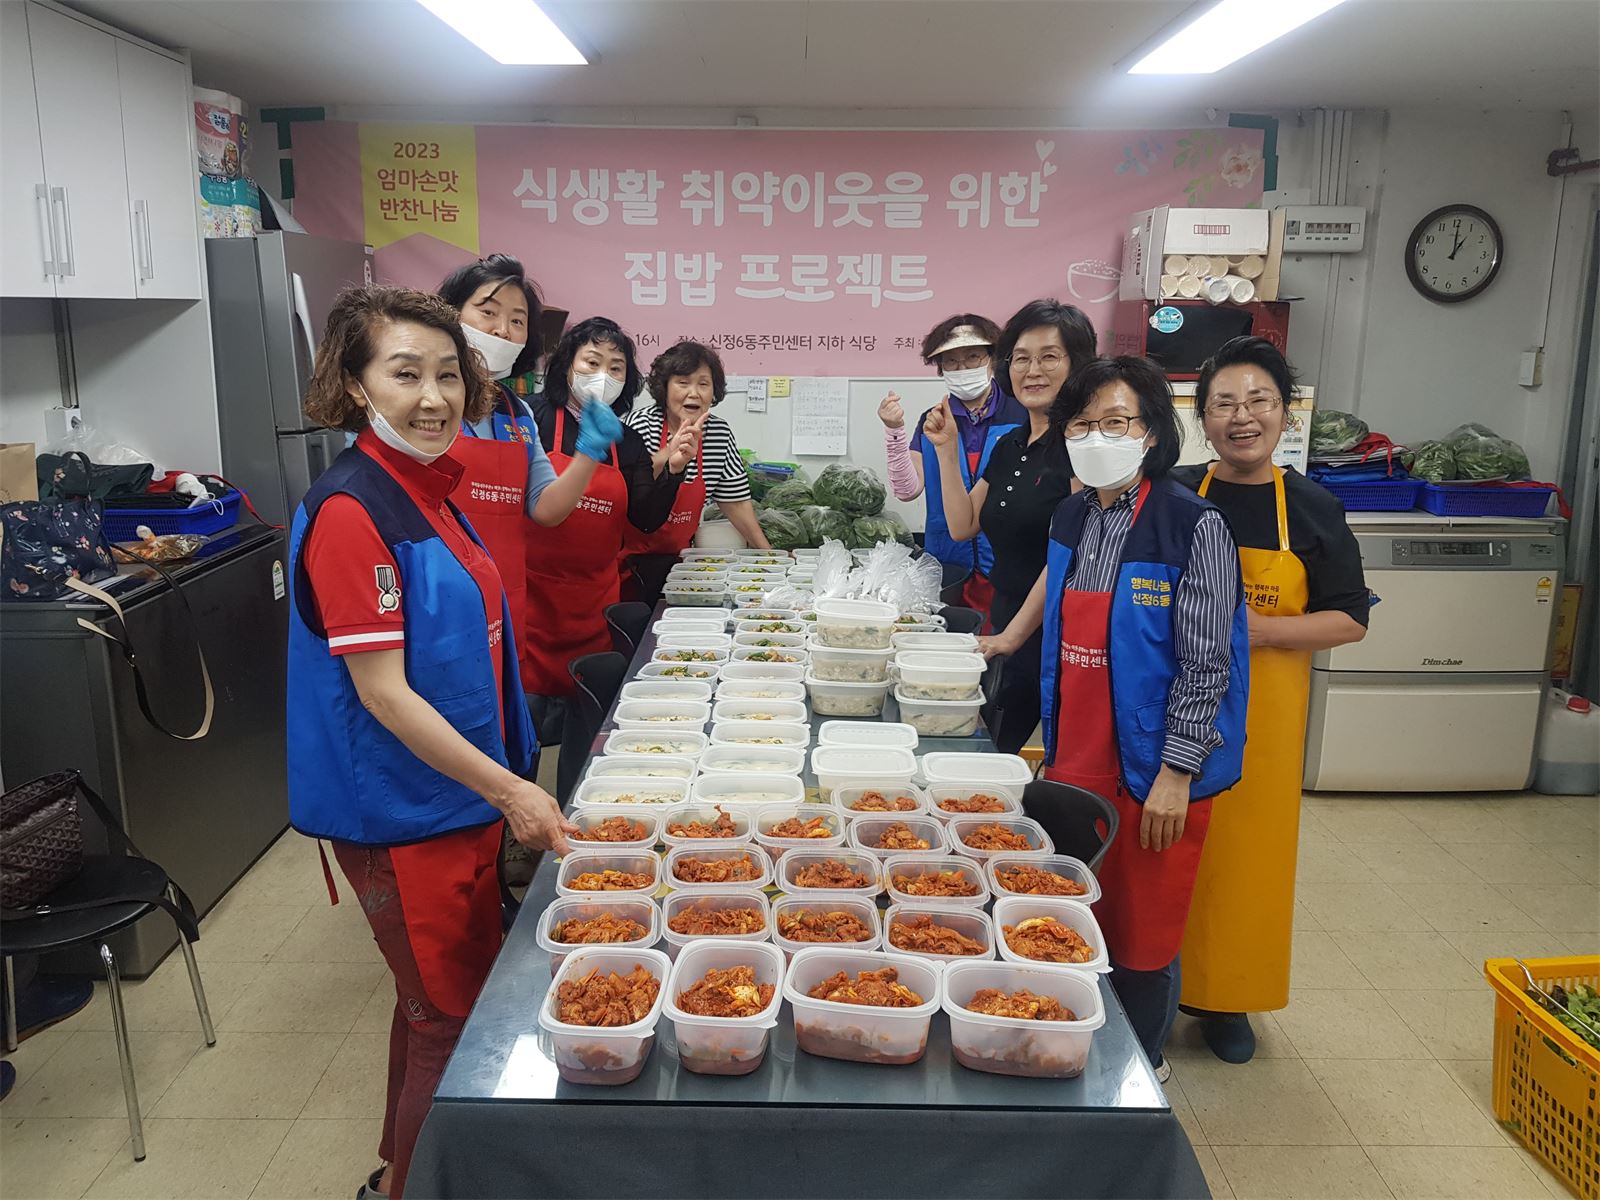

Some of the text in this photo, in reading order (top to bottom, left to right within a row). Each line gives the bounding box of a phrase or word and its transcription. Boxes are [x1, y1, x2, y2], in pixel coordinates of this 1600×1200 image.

[394, 142, 440, 159] 2023
[377, 168, 459, 193] 엄마손맛
[513, 167, 1048, 229] 식생활 취약이웃을 위한
[380, 198, 460, 222] 반찬나눔
[1439, 223, 1446, 231] 11
[1453, 219, 1461, 228] 12
[1426, 235, 1435, 244] 10
[1420, 249, 1426, 257] 9
[1480, 251, 1487, 259] 3
[1422, 265, 1429, 274] 8
[624, 251, 934, 308] 집밥 프로젝트
[1432, 276, 1438, 285] 7
[1461, 277, 1467, 286] 5
[635, 334, 660, 347] 16시
[709, 334, 812, 351] 신정6동주민센터
[817, 335, 846, 350] 지하
[849, 335, 877, 351] 식당
[894, 336, 914, 349] 주최
[1131, 577, 1171, 592] 행복나눔
[1132, 592, 1171, 607] 신정6동
